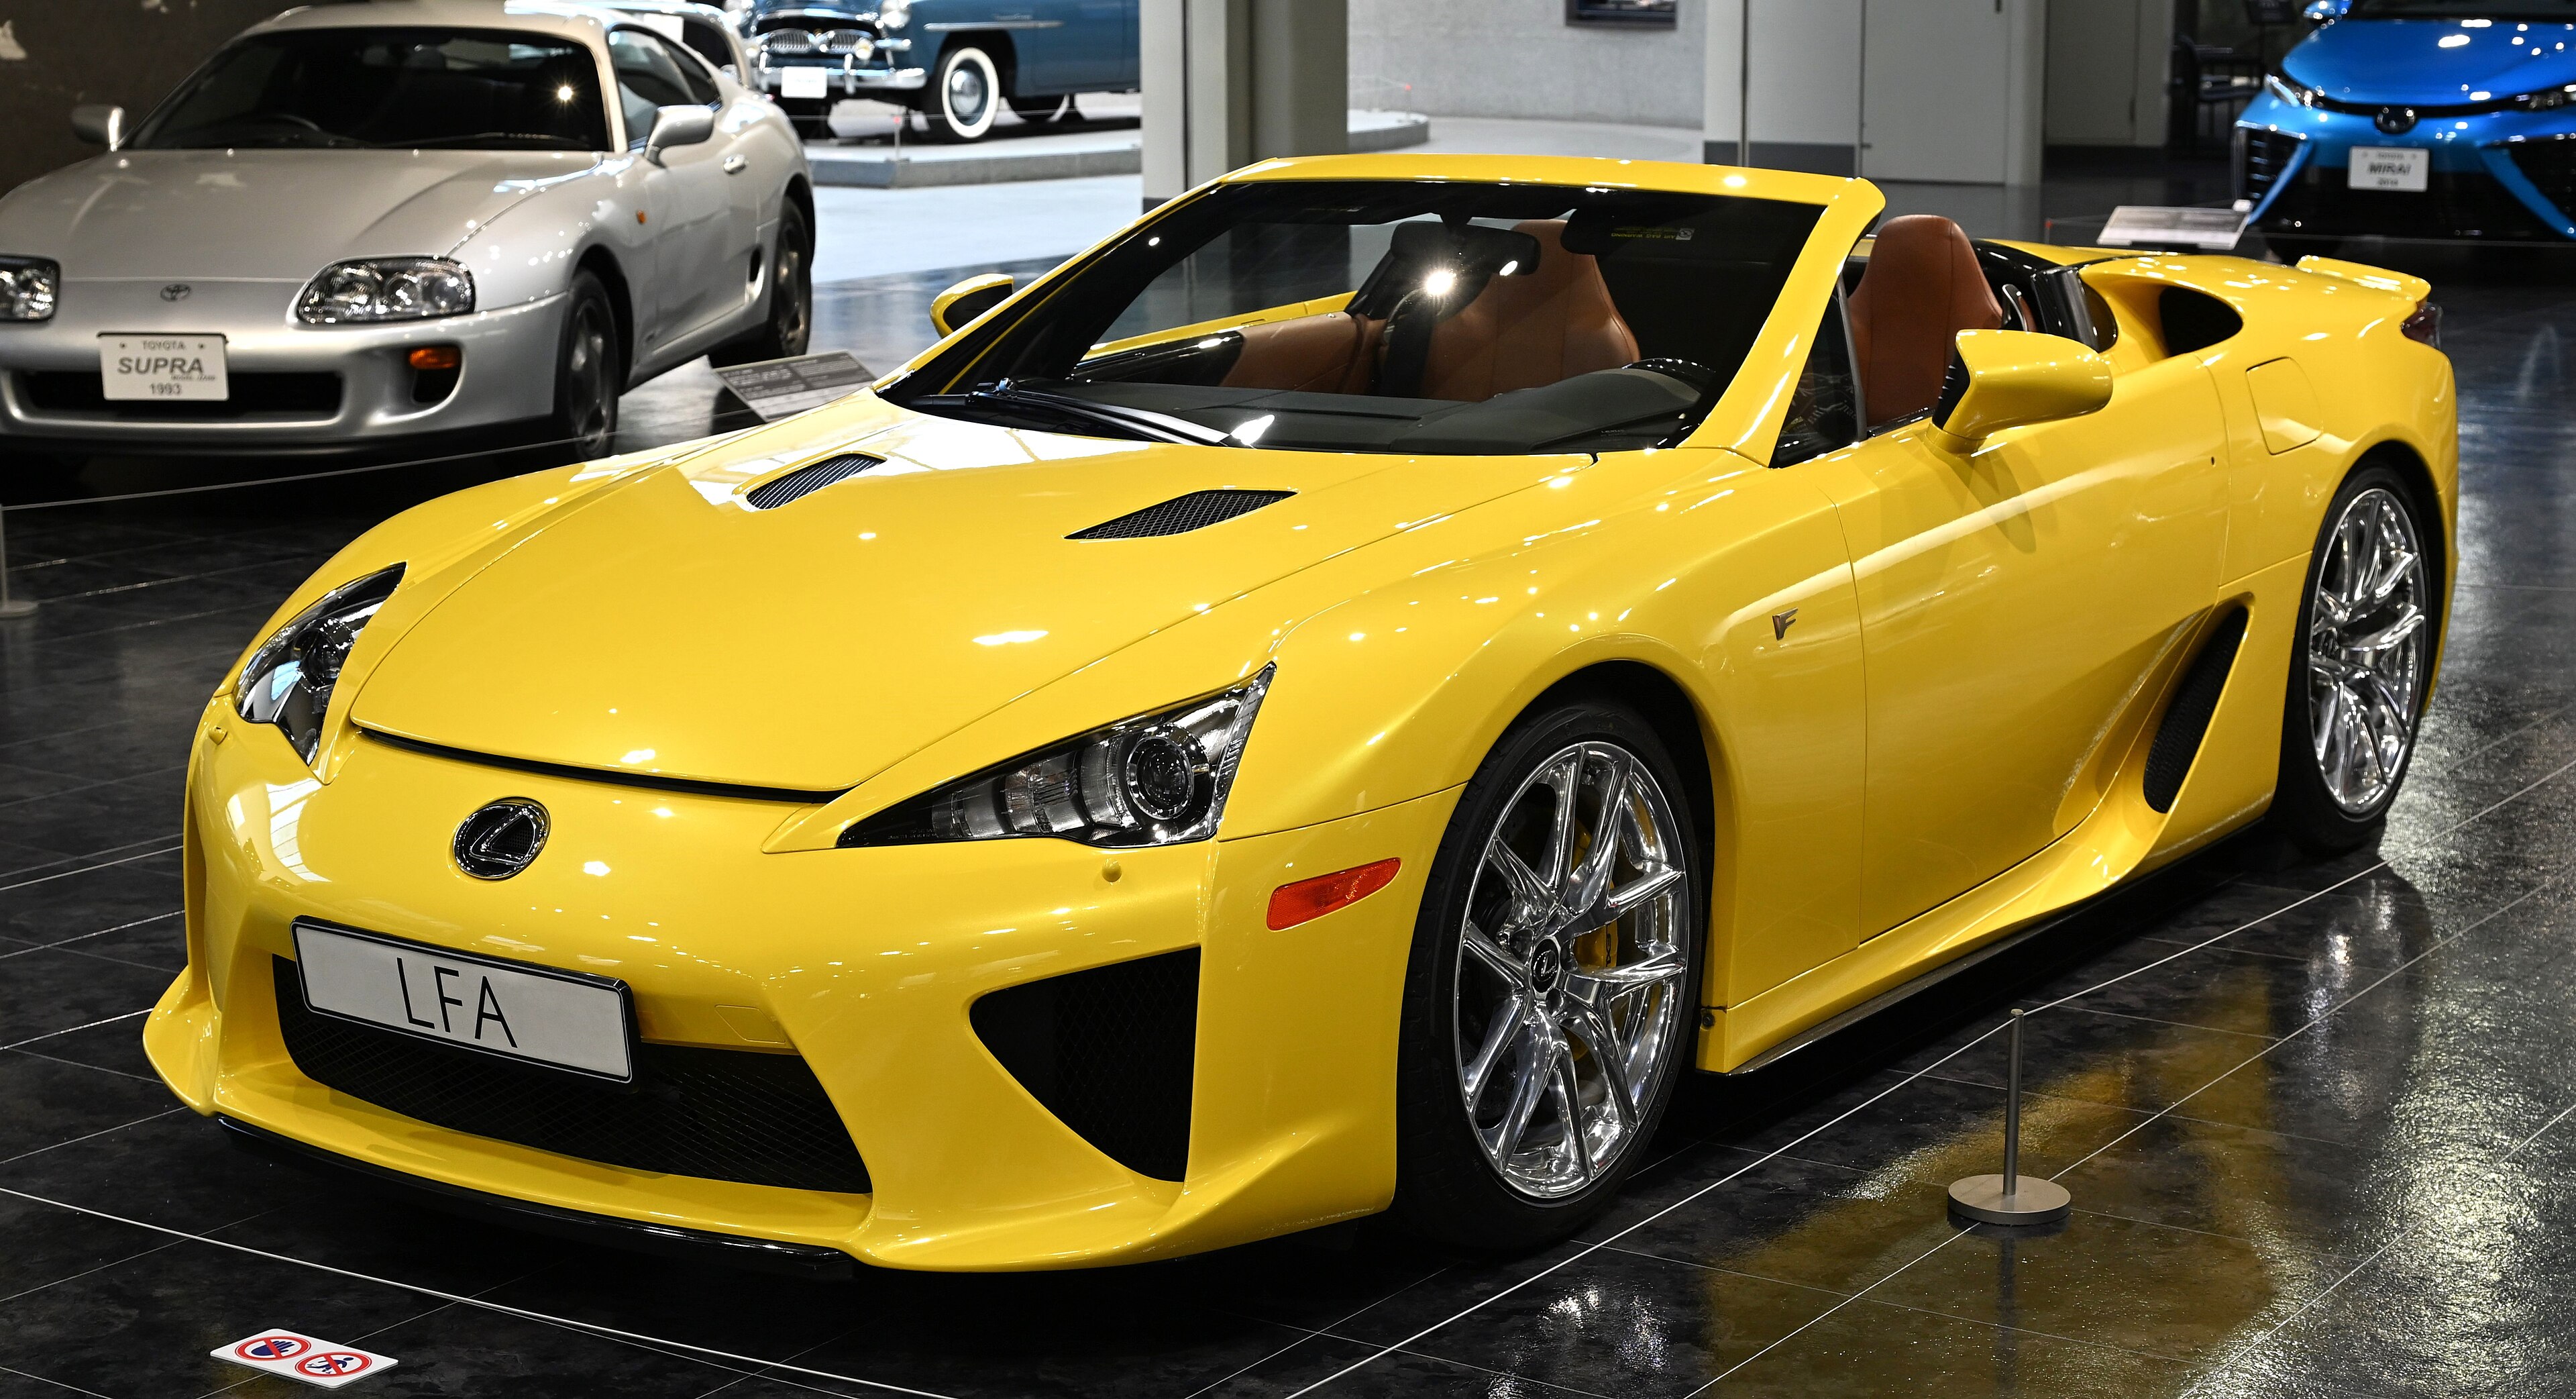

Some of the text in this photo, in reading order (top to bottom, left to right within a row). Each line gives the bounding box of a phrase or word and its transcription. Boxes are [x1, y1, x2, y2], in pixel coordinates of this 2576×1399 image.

[2369, 162, 2412, 176] MIRAI
[142, 341, 185, 350] TOYOTA
[117, 357, 203, 374] SUPRA
[150, 383, 182, 395] 1993
[396, 957, 518, 1048] LFA
